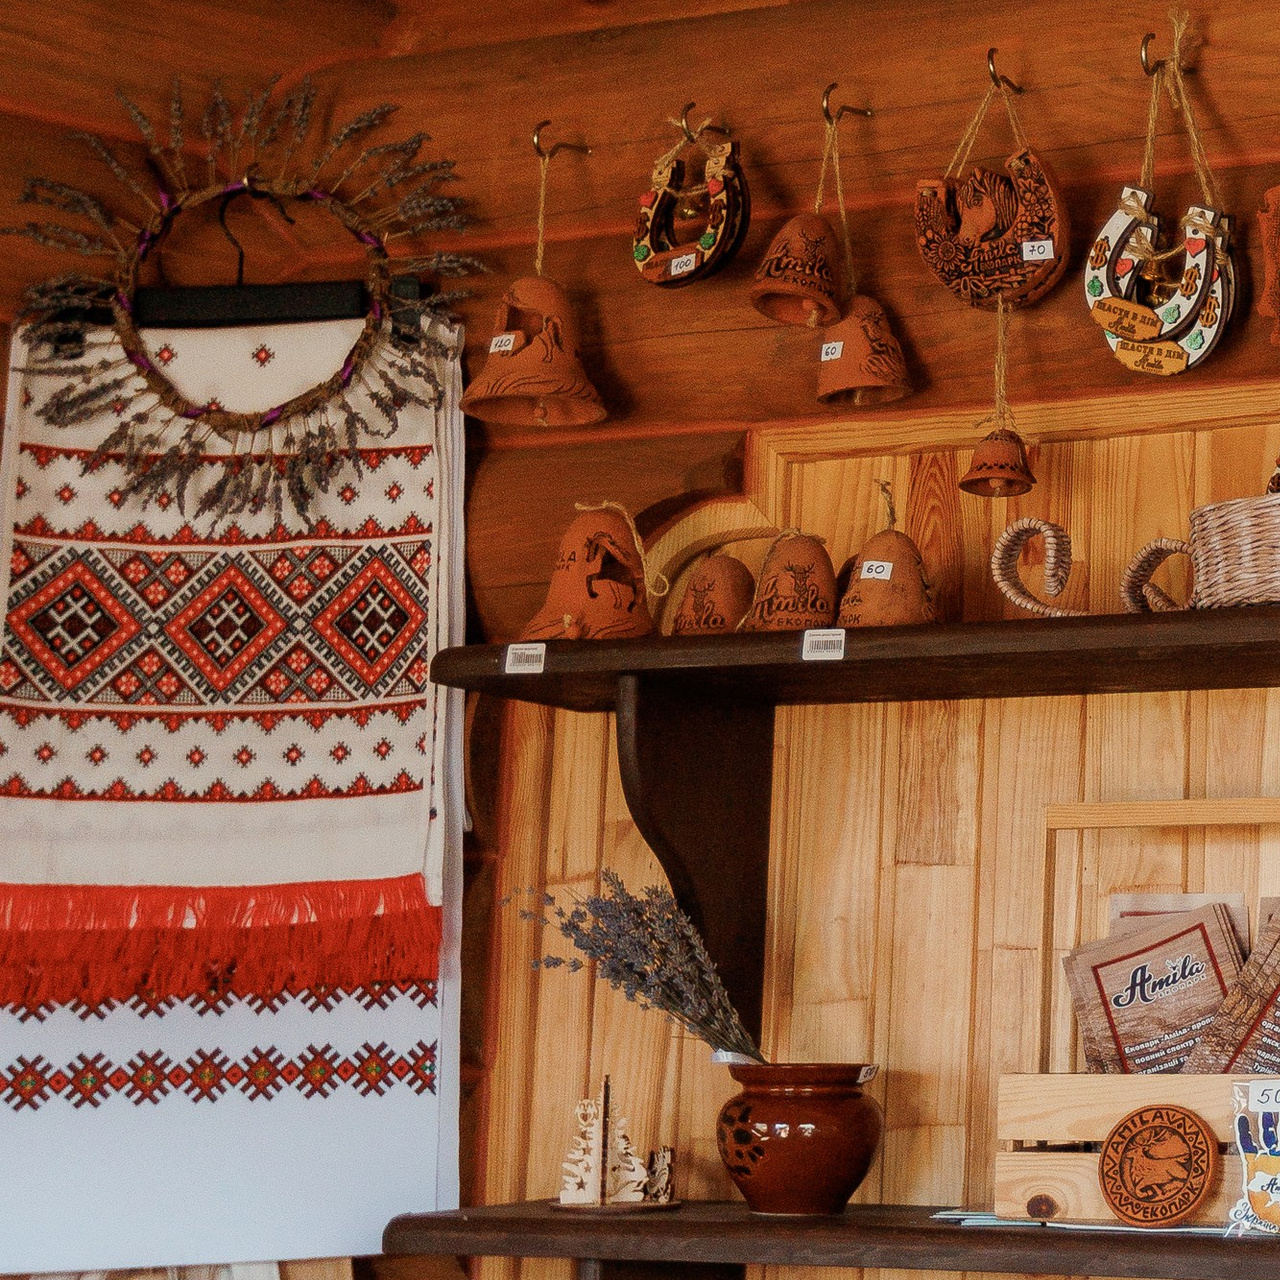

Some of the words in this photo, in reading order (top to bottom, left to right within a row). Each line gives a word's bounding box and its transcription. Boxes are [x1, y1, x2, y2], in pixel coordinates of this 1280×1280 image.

[756, 240, 832, 281] Amila
[980, 254, 1022, 271] ЕКОПАРК
[1029, 244, 1046, 255] 70
[675, 259, 692, 271] 100
[824, 346, 837, 357] 60
[867, 564, 885, 574] 60
[754, 577, 830, 624] Amila
[1112, 954, 1206, 1008] Amila
[1158, 973, 1207, 999] ЕКОПАРК
[1124, 1038, 1160, 1054] Екопарк
[1135, 1049, 1165, 1065] повний
[1166, 1038, 1194, 1054] спектр
[1111, 1111, 1164, 1155] AMILA
[1142, 1180, 1200, 1218] ЕКОПАРК
